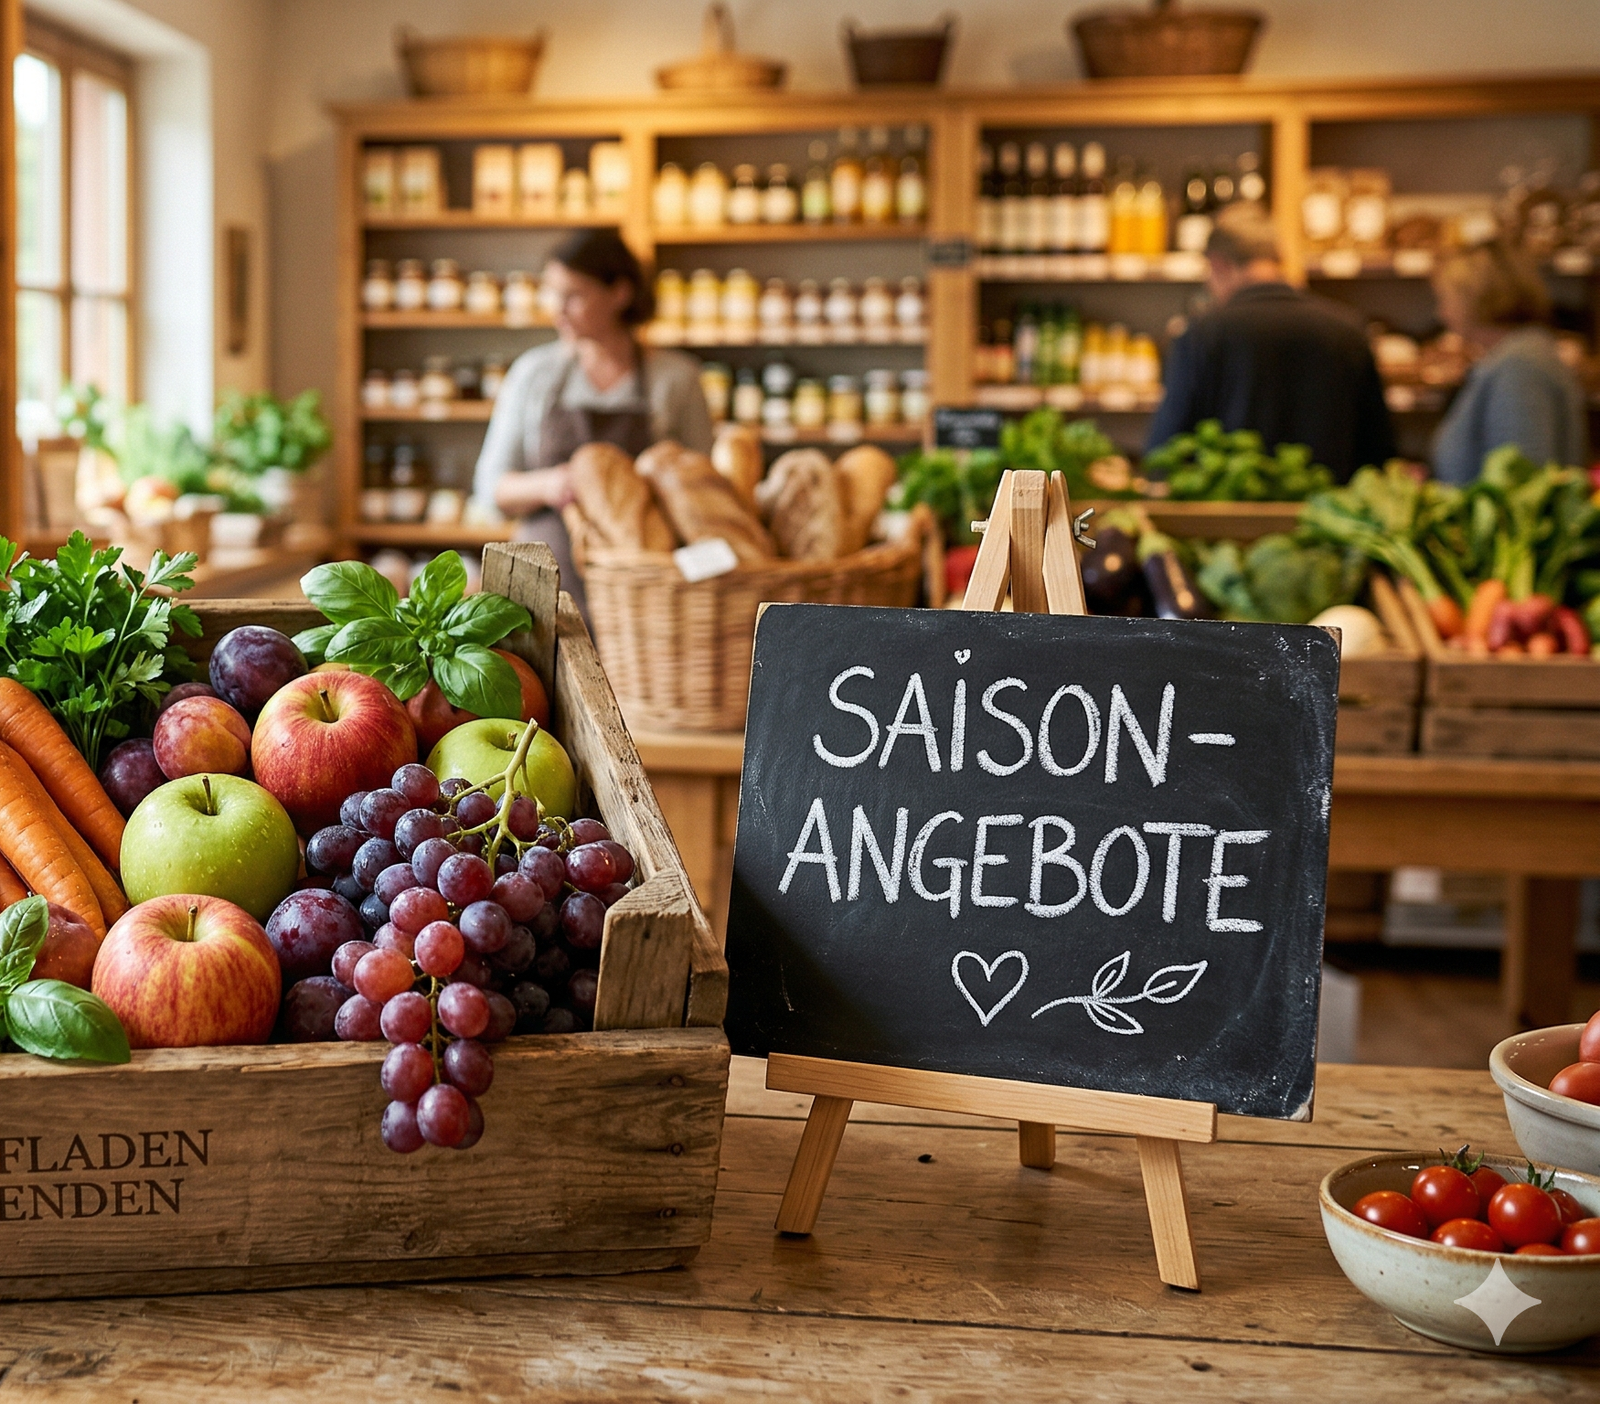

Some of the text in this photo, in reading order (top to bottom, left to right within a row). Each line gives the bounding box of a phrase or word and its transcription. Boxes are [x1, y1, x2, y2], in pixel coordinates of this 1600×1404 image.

[777, 797, 1272, 934] ANGEBOTE
[0, 1128, 214, 1175] FLADEN
[0, 1177, 185, 1222] ENDEN
